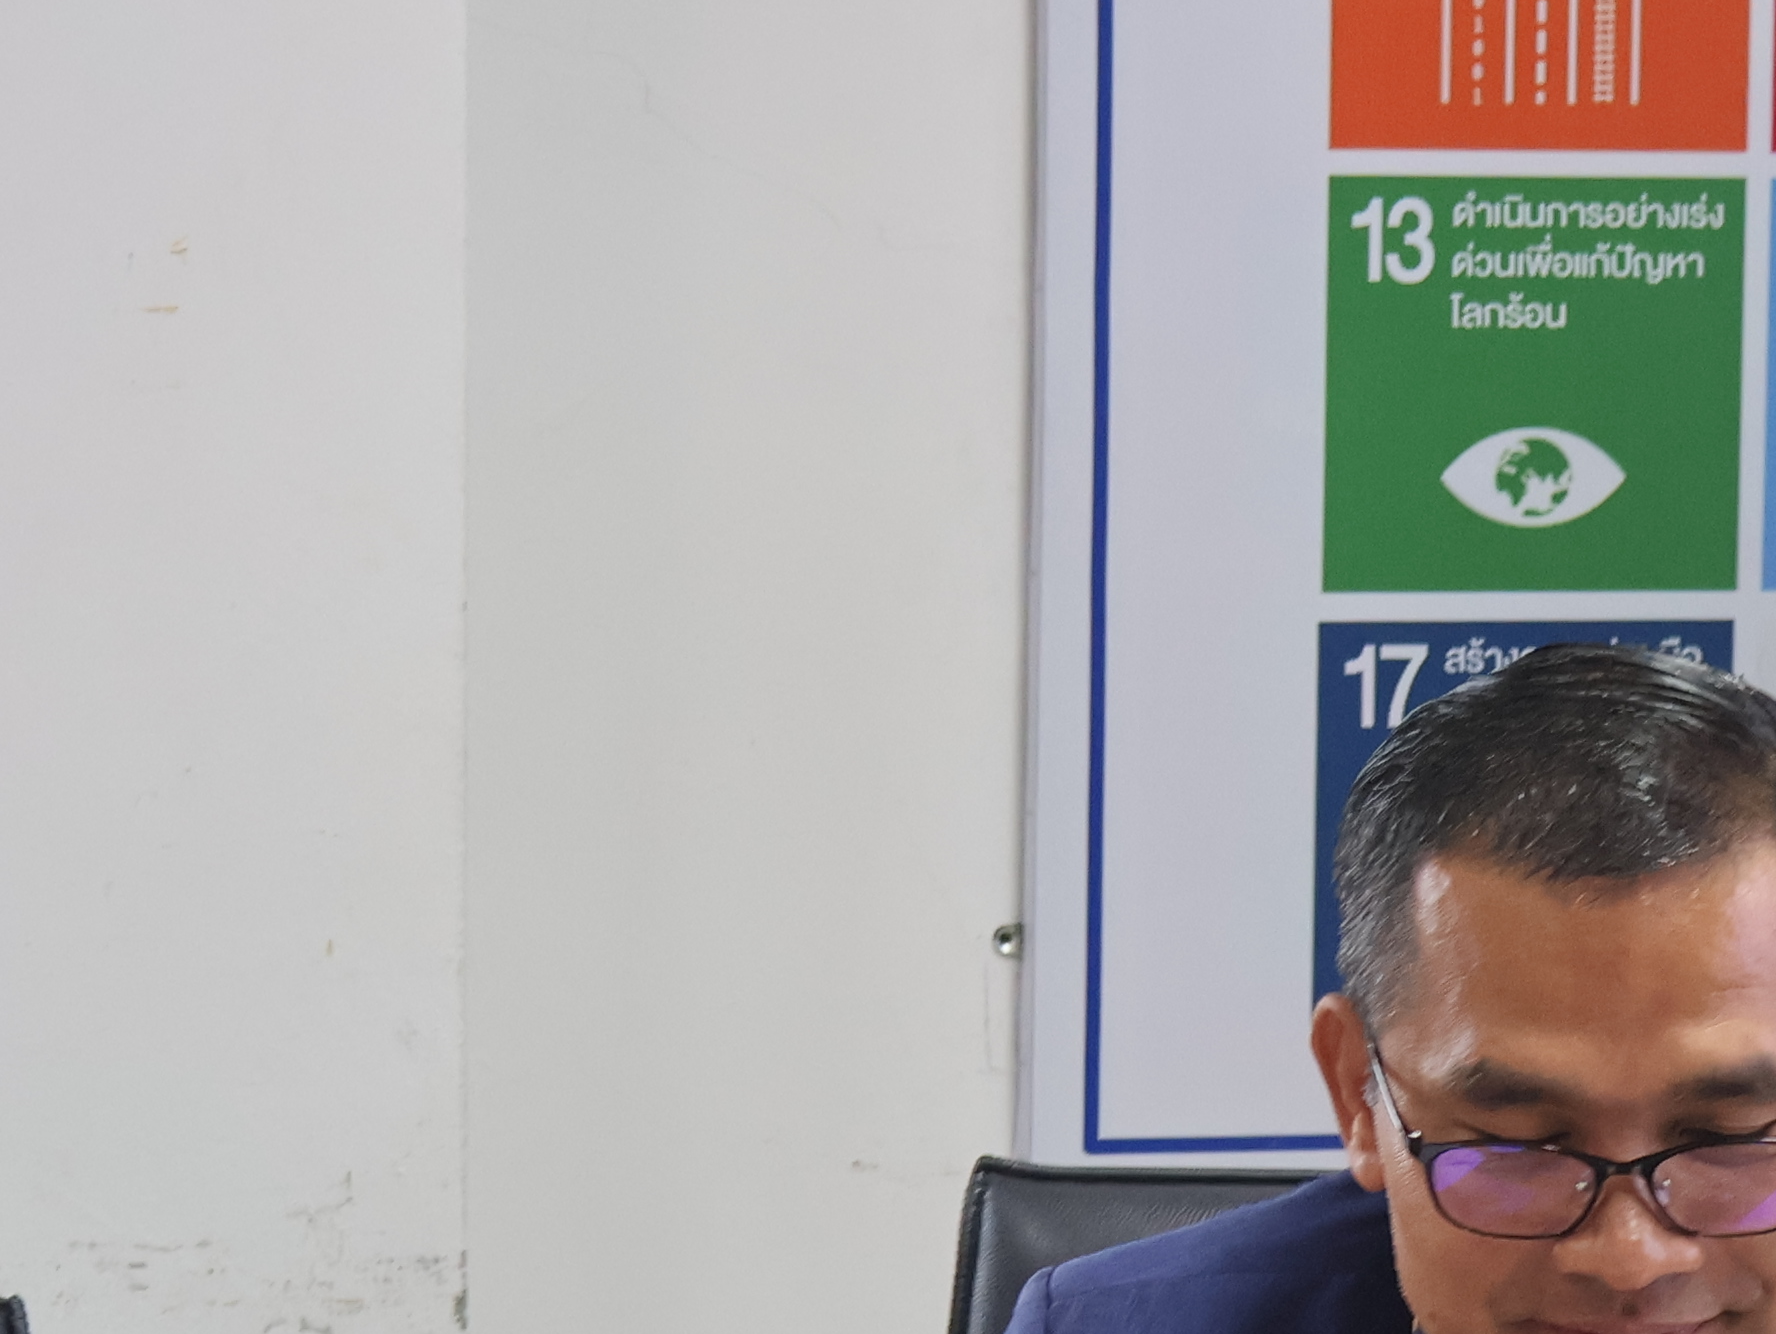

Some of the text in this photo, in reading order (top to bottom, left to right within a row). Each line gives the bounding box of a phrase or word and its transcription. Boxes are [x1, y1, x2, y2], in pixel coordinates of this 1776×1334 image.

[1451, 190, 1726, 233] ดำเนินการอย่างเร่ง
[1350, 196, 1436, 284] 13
[1451, 233, 1705, 285] ด่วนเพื่อแก้ปัญหา
[1451, 290, 1567, 330] โลกร้อน
[1343, 643, 1429, 730] 17
